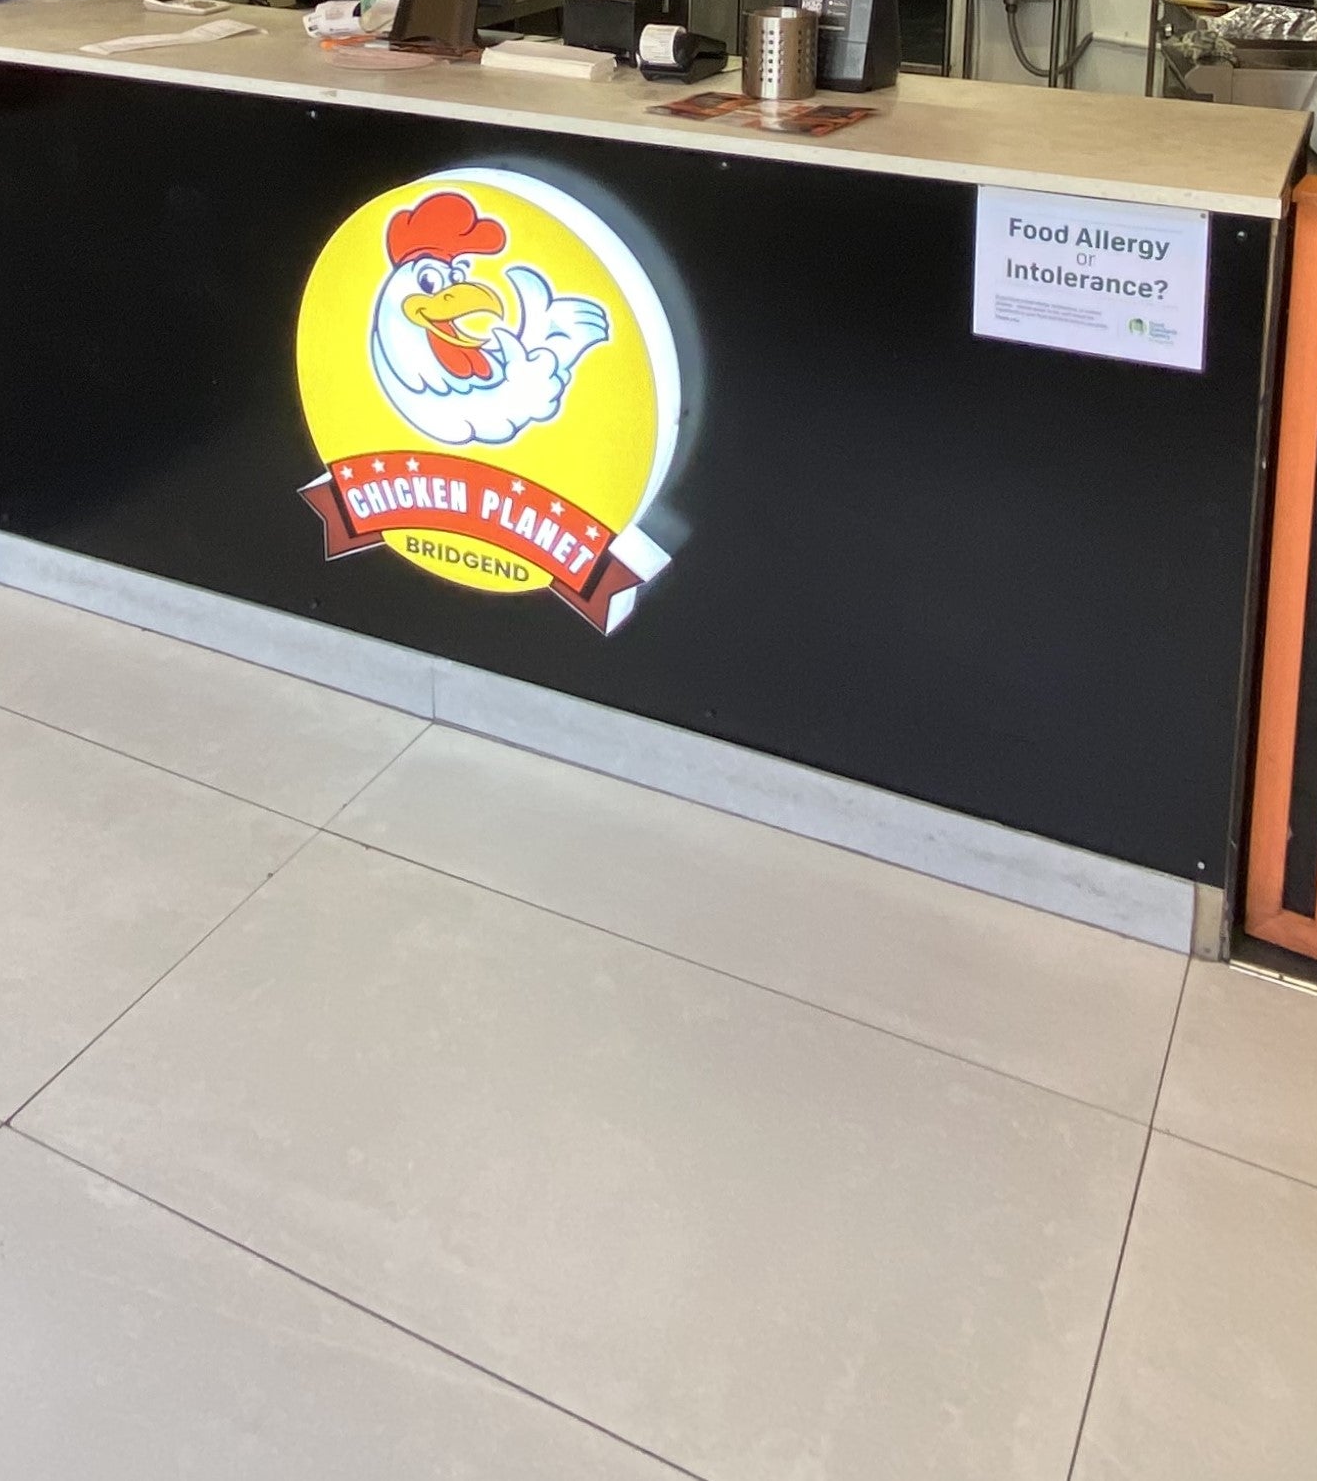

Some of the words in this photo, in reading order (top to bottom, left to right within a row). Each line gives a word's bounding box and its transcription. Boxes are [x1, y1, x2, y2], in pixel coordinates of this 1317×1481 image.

[1008, 217, 1069, 245] Food
[1075, 227, 1170, 261] Allergy
[1076, 252, 1097, 267] or
[1006, 258, 1169, 300] Intolerance?
[345, 475, 469, 520] CHICKEN
[479, 488, 597, 576] PLANET
[405, 533, 530, 583] BRIDGEND
